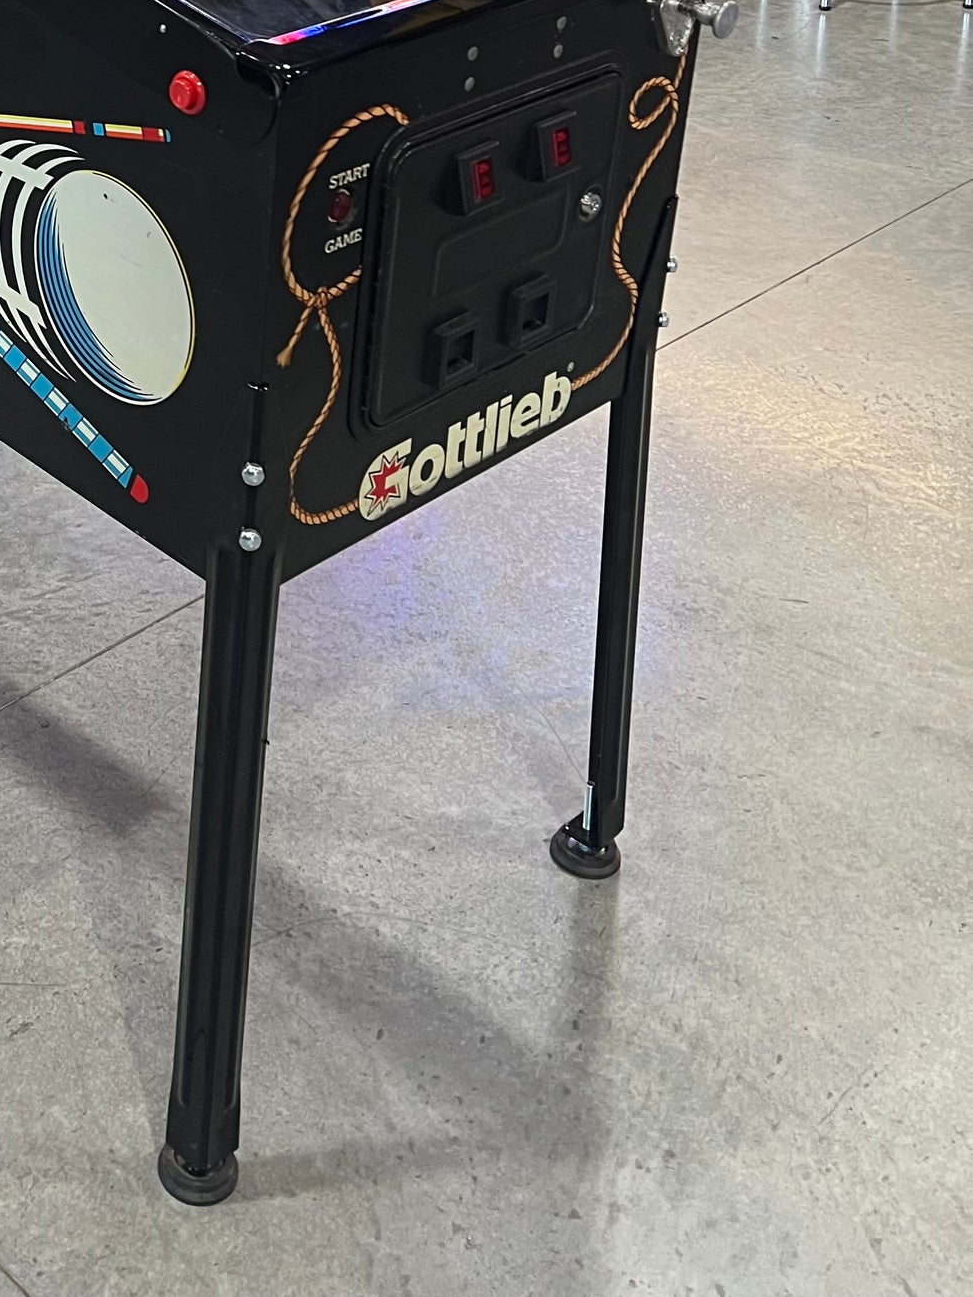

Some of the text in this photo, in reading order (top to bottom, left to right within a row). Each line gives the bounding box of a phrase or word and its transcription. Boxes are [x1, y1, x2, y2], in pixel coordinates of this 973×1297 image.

[329, 163, 371, 190] START
[324, 227, 363, 254] GAME
[358, 371, 573, 522] Gottlieb
